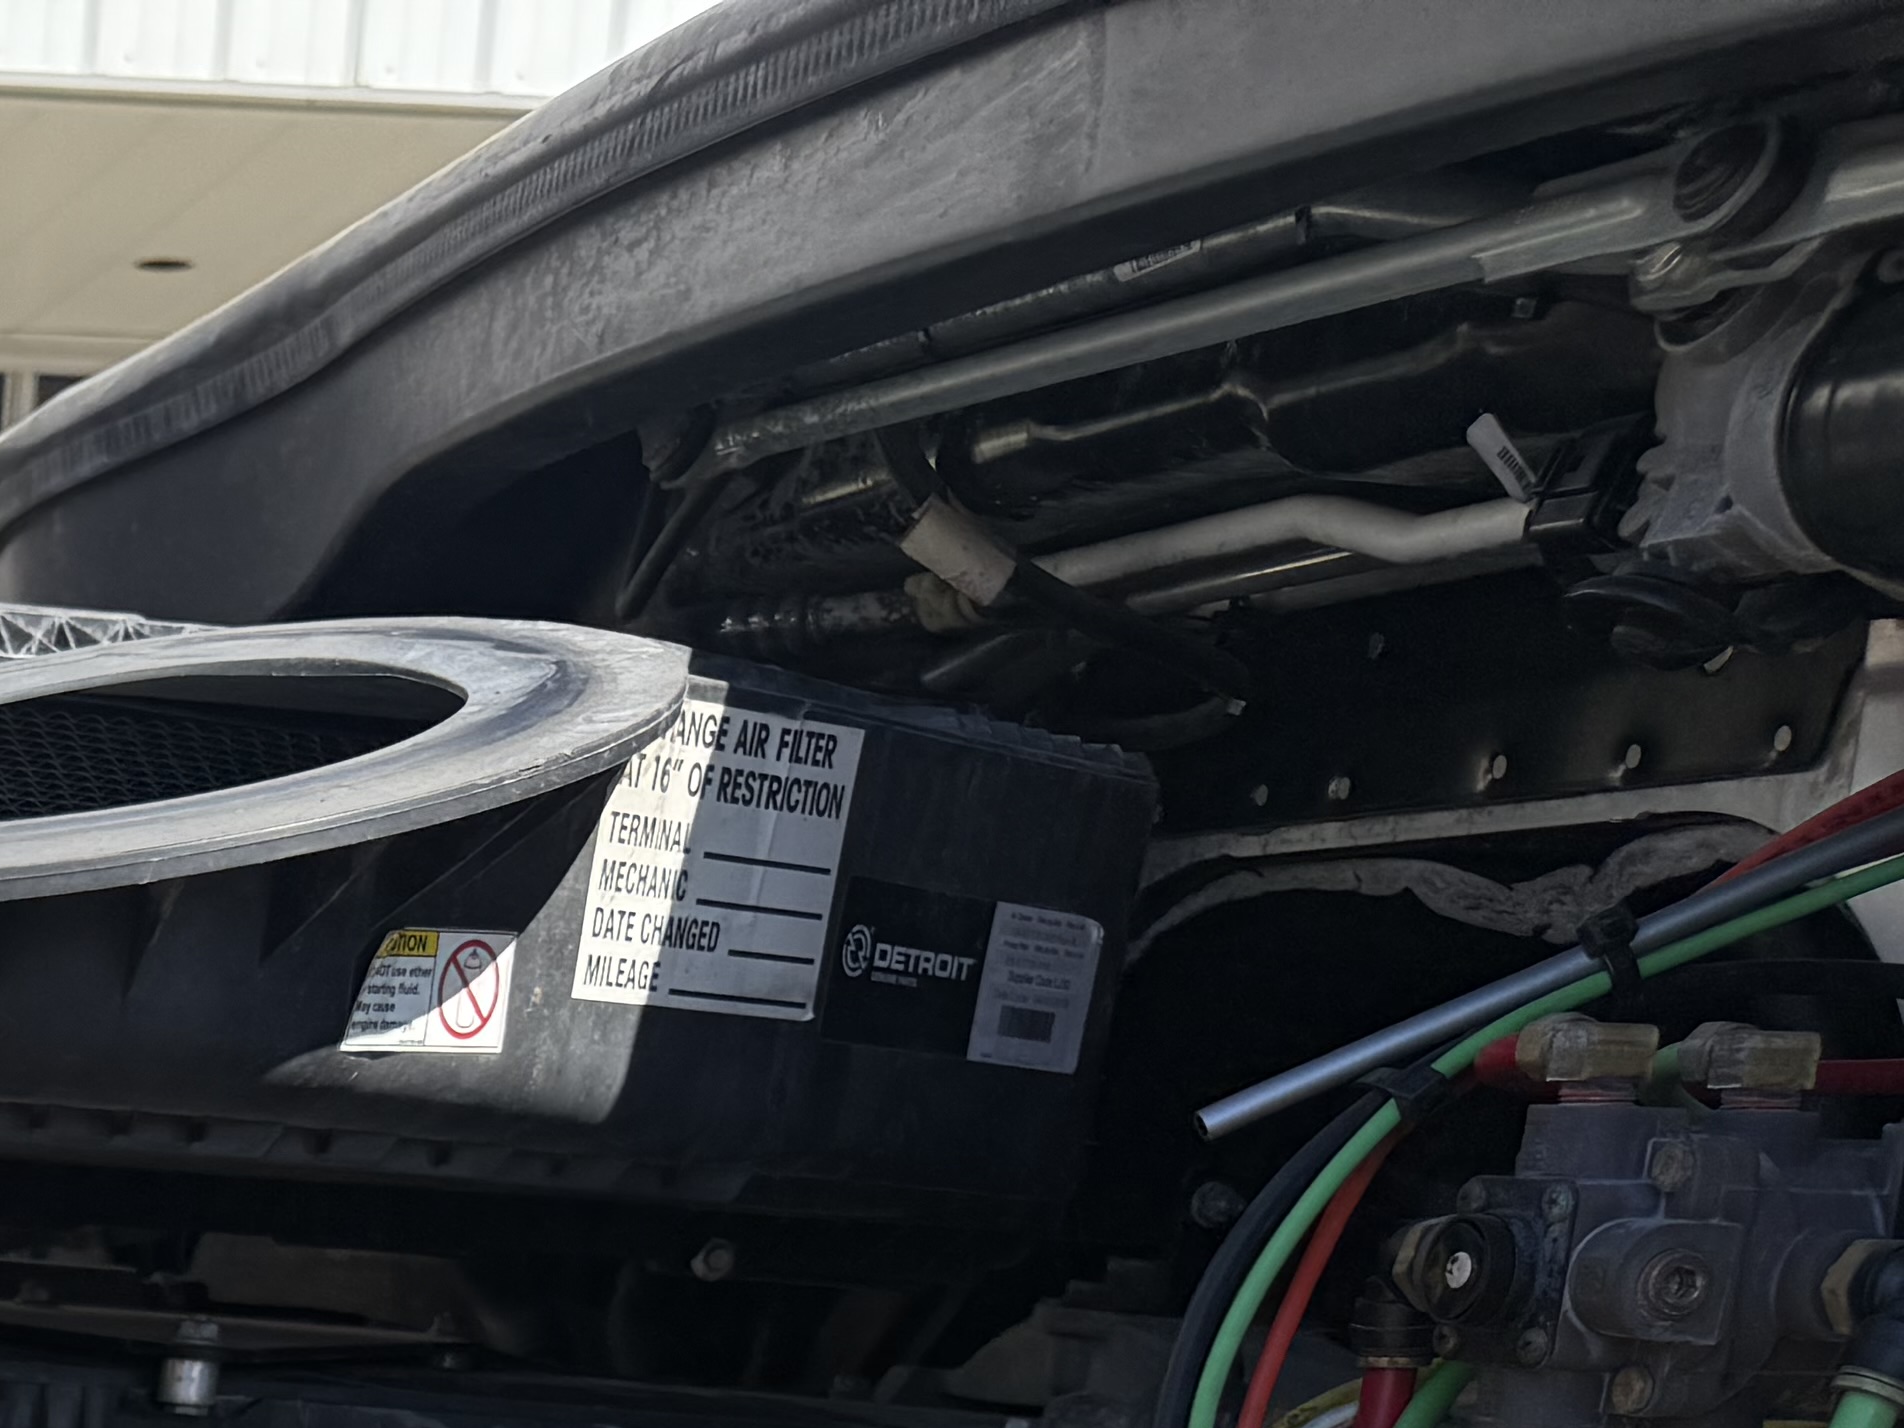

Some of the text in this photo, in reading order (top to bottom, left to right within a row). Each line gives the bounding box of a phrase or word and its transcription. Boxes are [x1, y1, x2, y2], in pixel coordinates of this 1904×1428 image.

[671, 710, 838, 770] ANGE AIR FILTER
[619, 752, 646, 788] AT
[688, 762, 714, 800] OF
[717, 767, 845, 820] RESTRICTION
[609, 811, 691, 855] TERMINAL
[598, 859, 688, 901] MECHANIC
[592, 907, 720, 952] DATE CHANGED
[583, 954, 661, 992] MILEAGE
[873, 942, 977, 981] DETROIT
